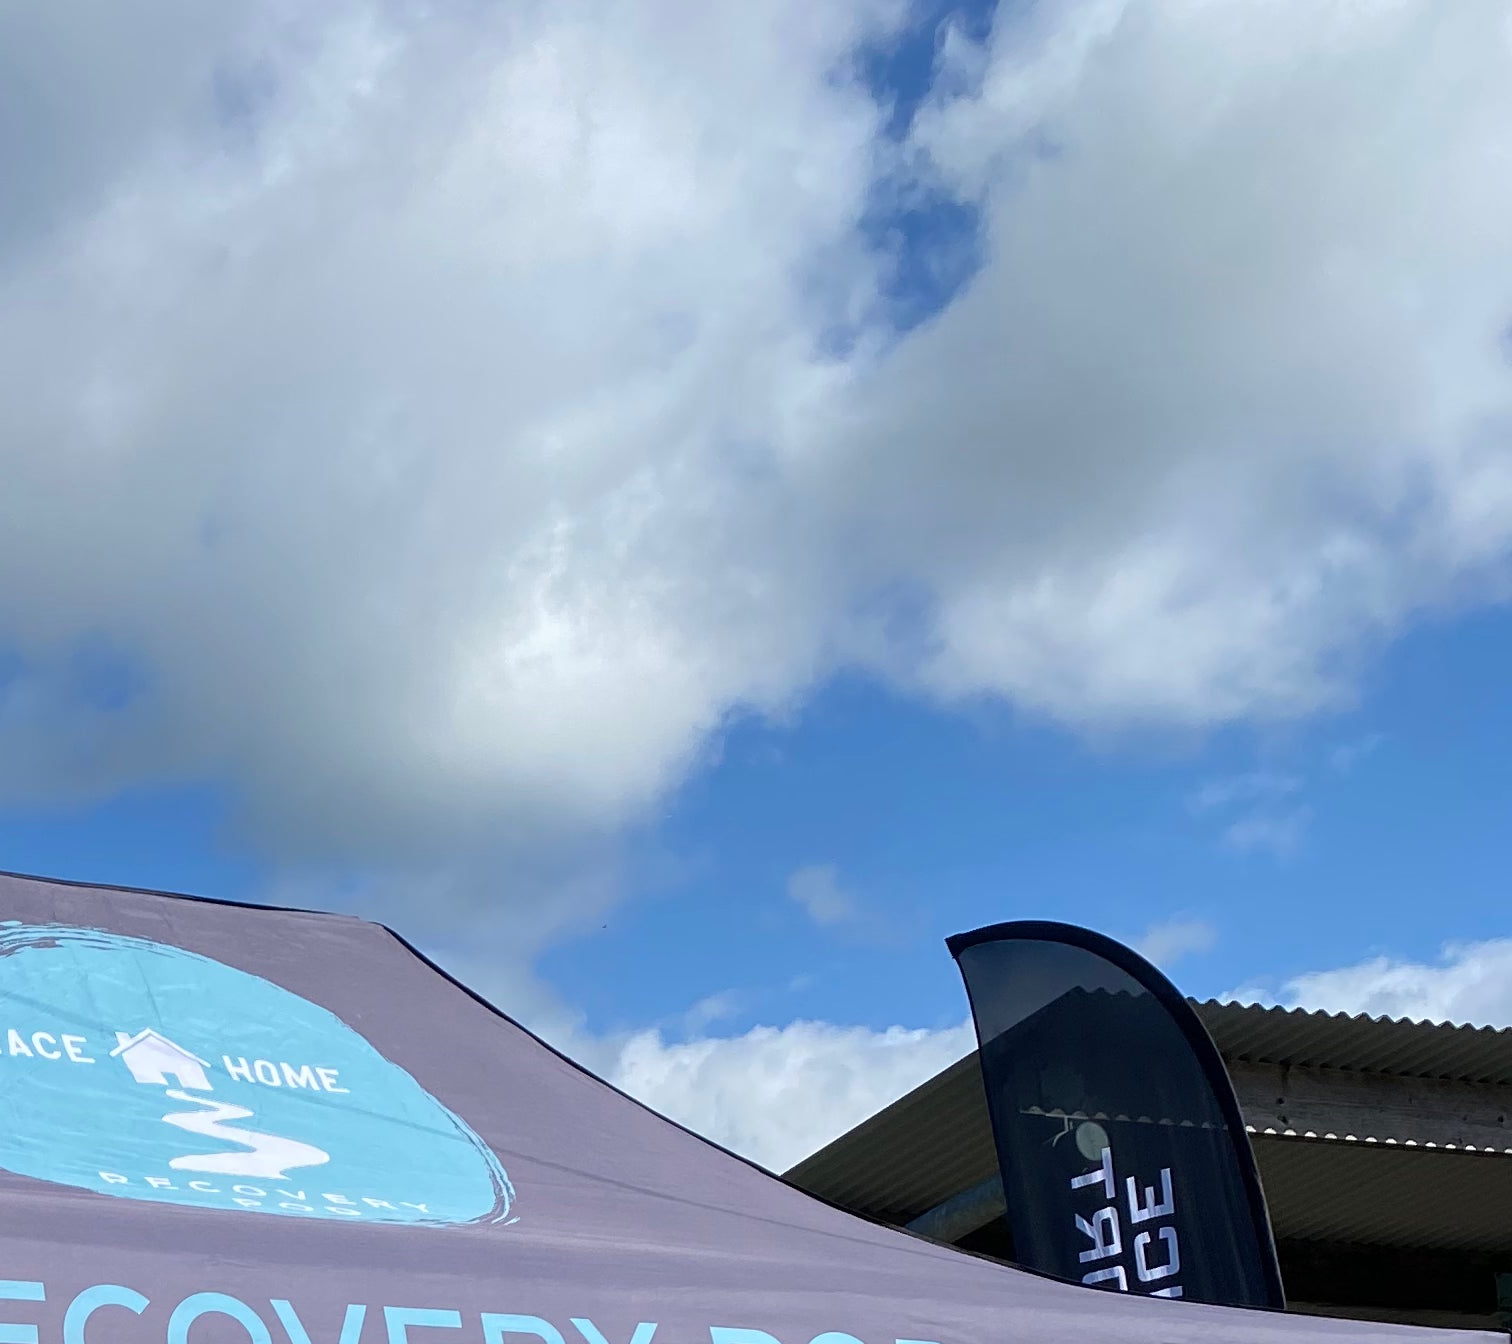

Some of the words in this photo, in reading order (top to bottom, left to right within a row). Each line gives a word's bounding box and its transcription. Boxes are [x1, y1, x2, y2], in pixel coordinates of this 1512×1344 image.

[221, 1055, 350, 1094] HOME
[98, 1170, 431, 1214] RECOVERY
[232, 1197, 362, 1216] POD
